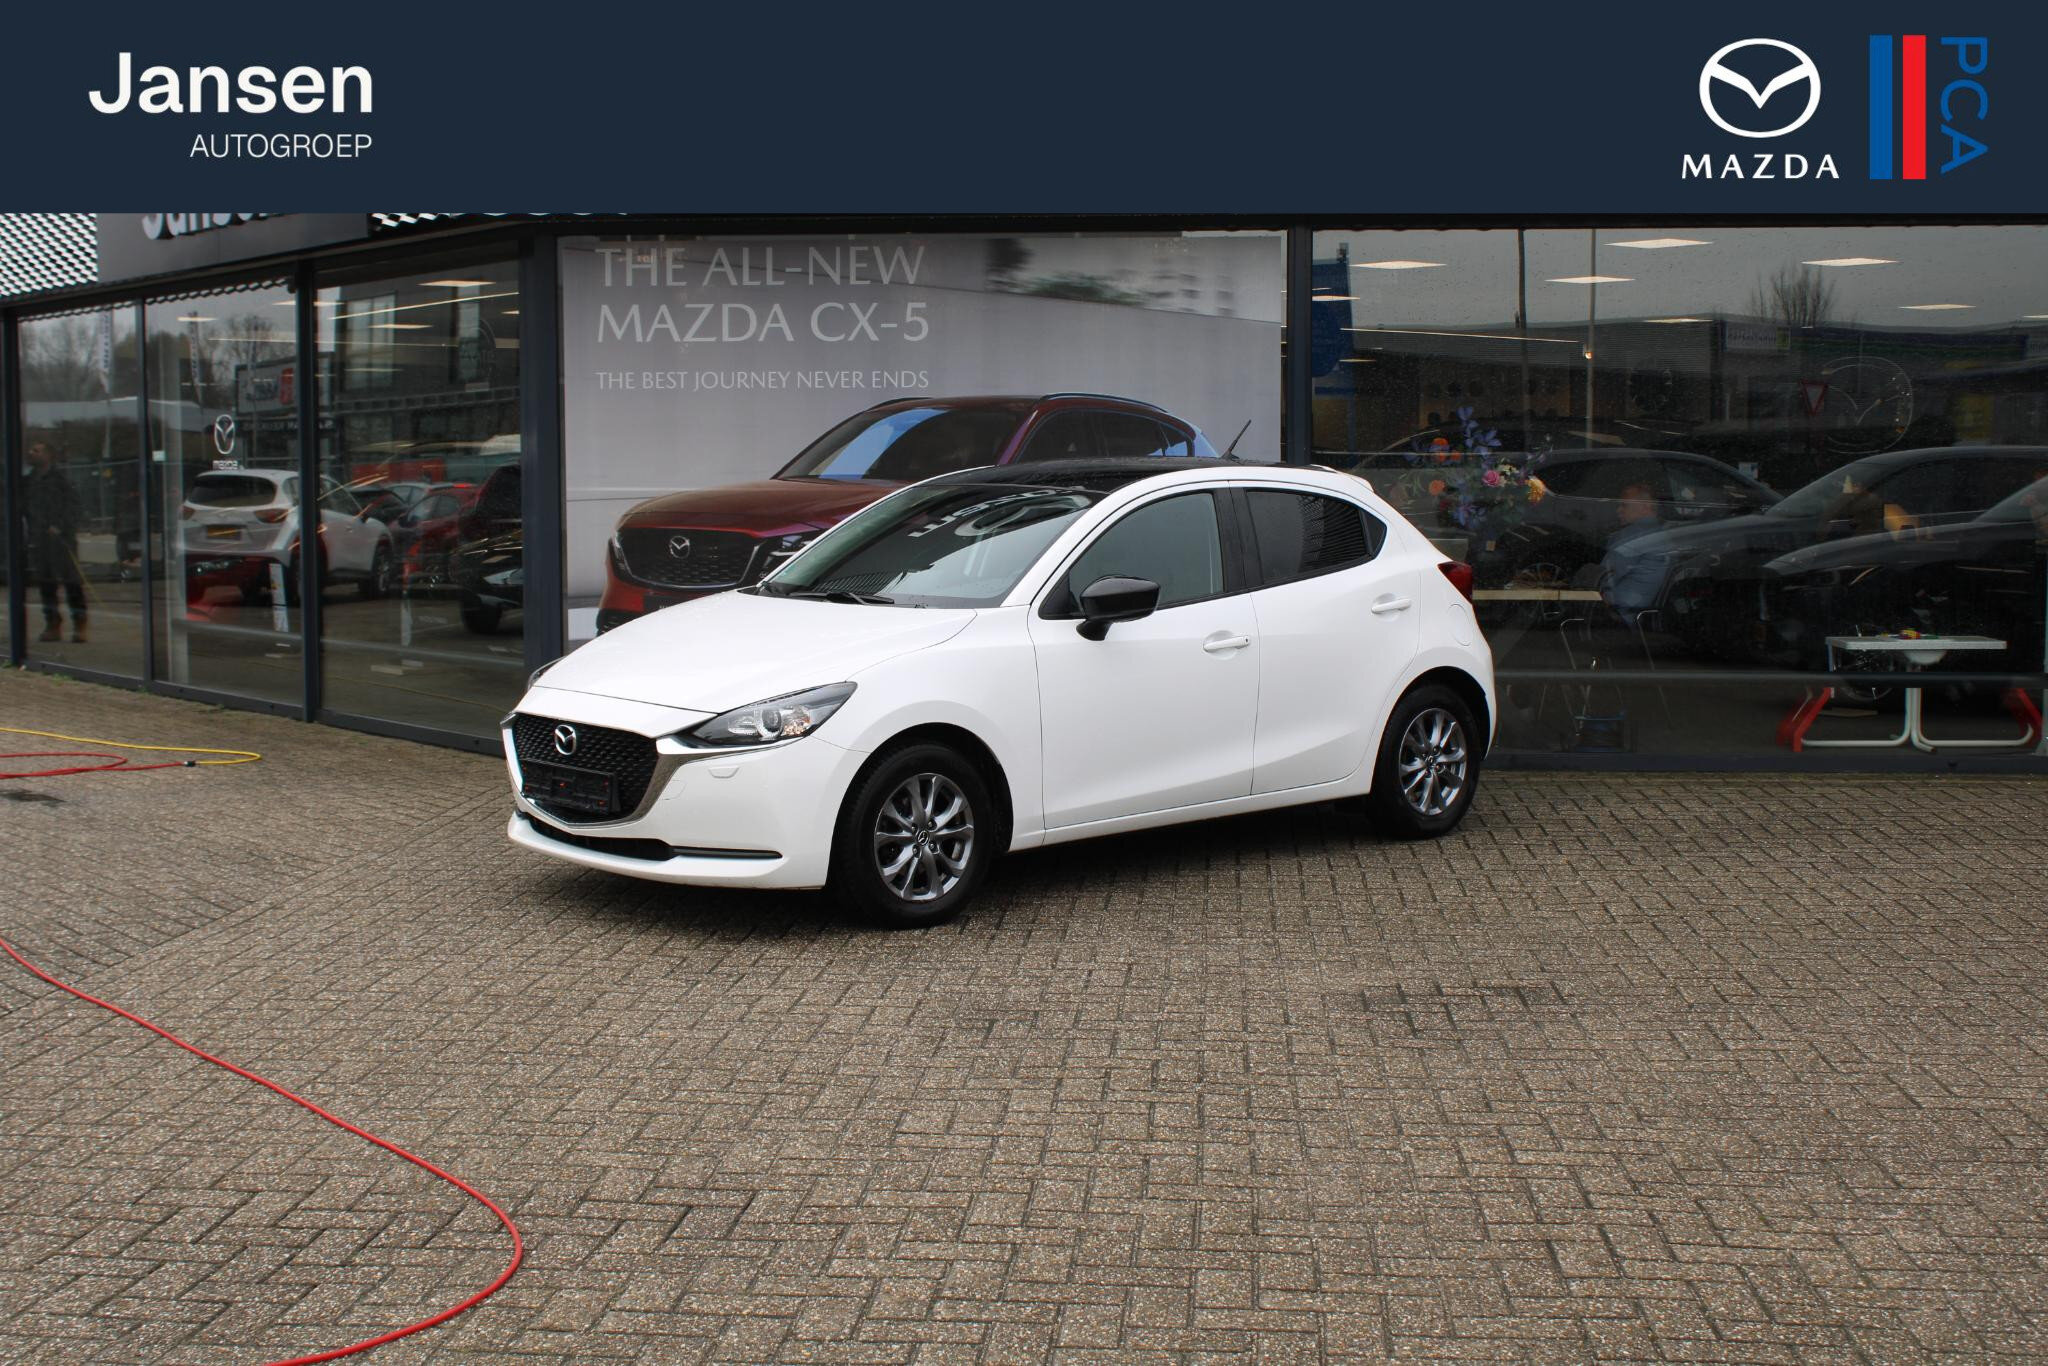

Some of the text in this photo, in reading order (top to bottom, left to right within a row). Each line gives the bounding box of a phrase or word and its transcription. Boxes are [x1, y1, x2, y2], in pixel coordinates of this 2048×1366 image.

[595, 245, 926, 287] THE ALL-NEW
[597, 302, 930, 343] MAZDA CX-5
[596, 370, 930, 392] THE BEST JOURNEY NEVER ENDS
